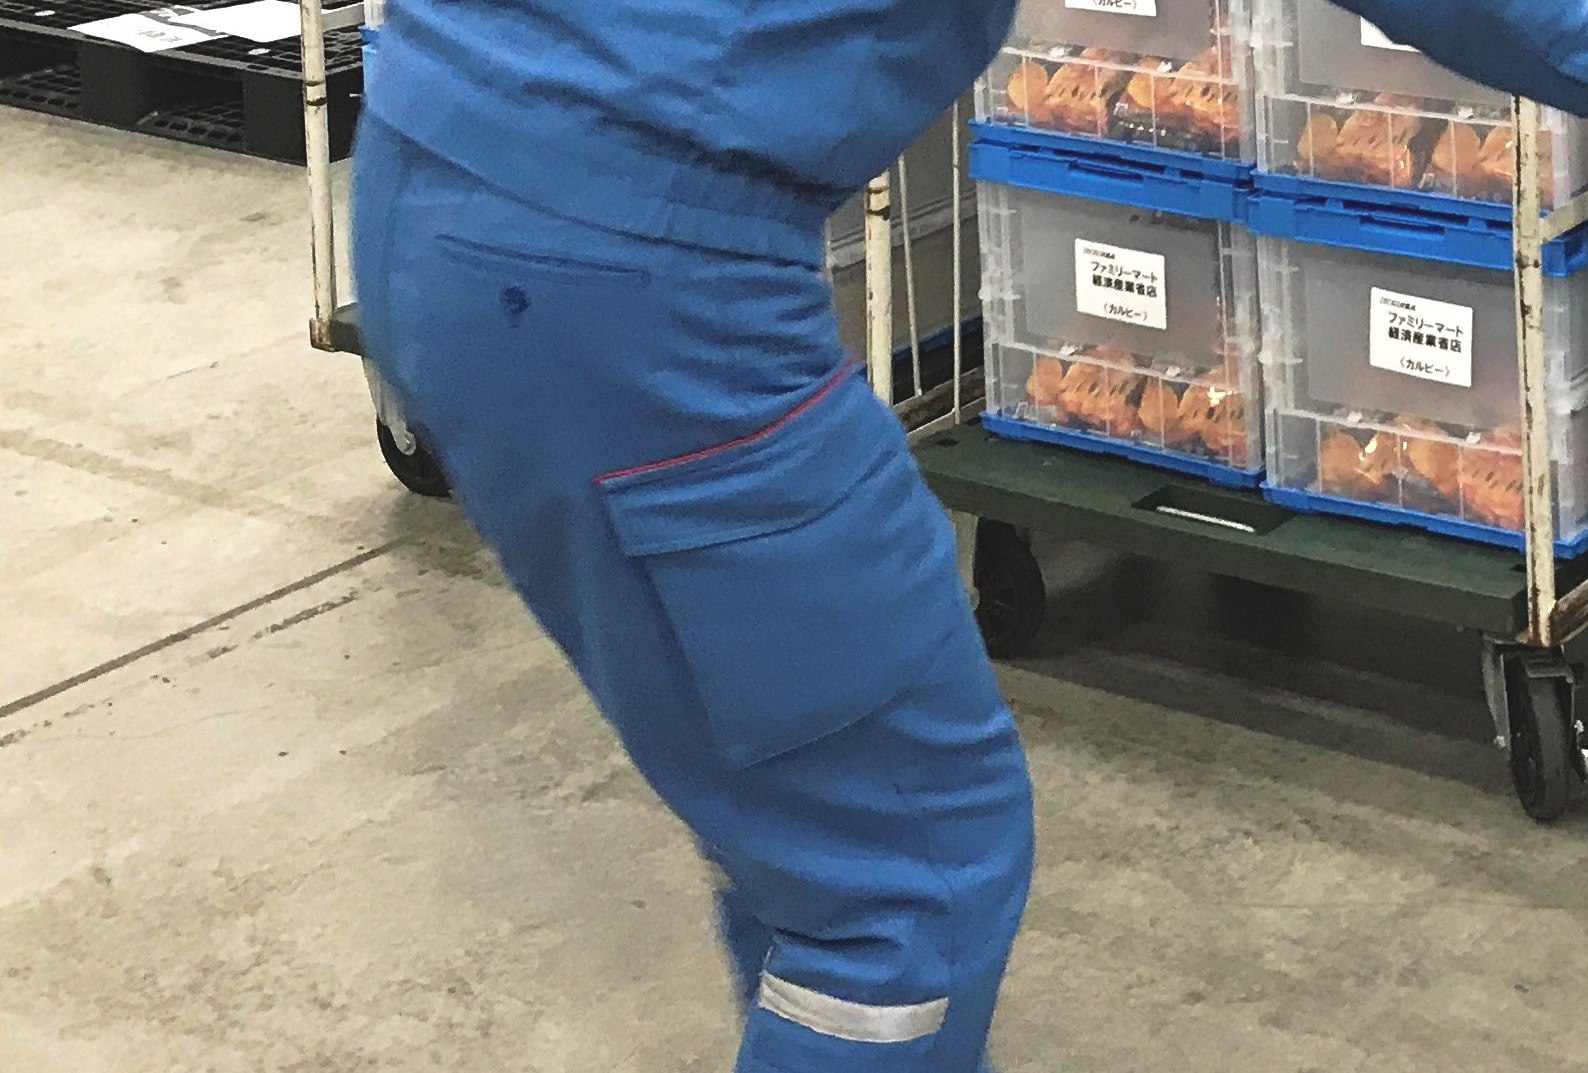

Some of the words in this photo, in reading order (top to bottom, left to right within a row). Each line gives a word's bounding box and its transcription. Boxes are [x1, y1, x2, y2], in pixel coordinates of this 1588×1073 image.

[1090, 260, 1158, 283] ファミリーマート
[1388, 311, 1464, 338] ファミリーマート
